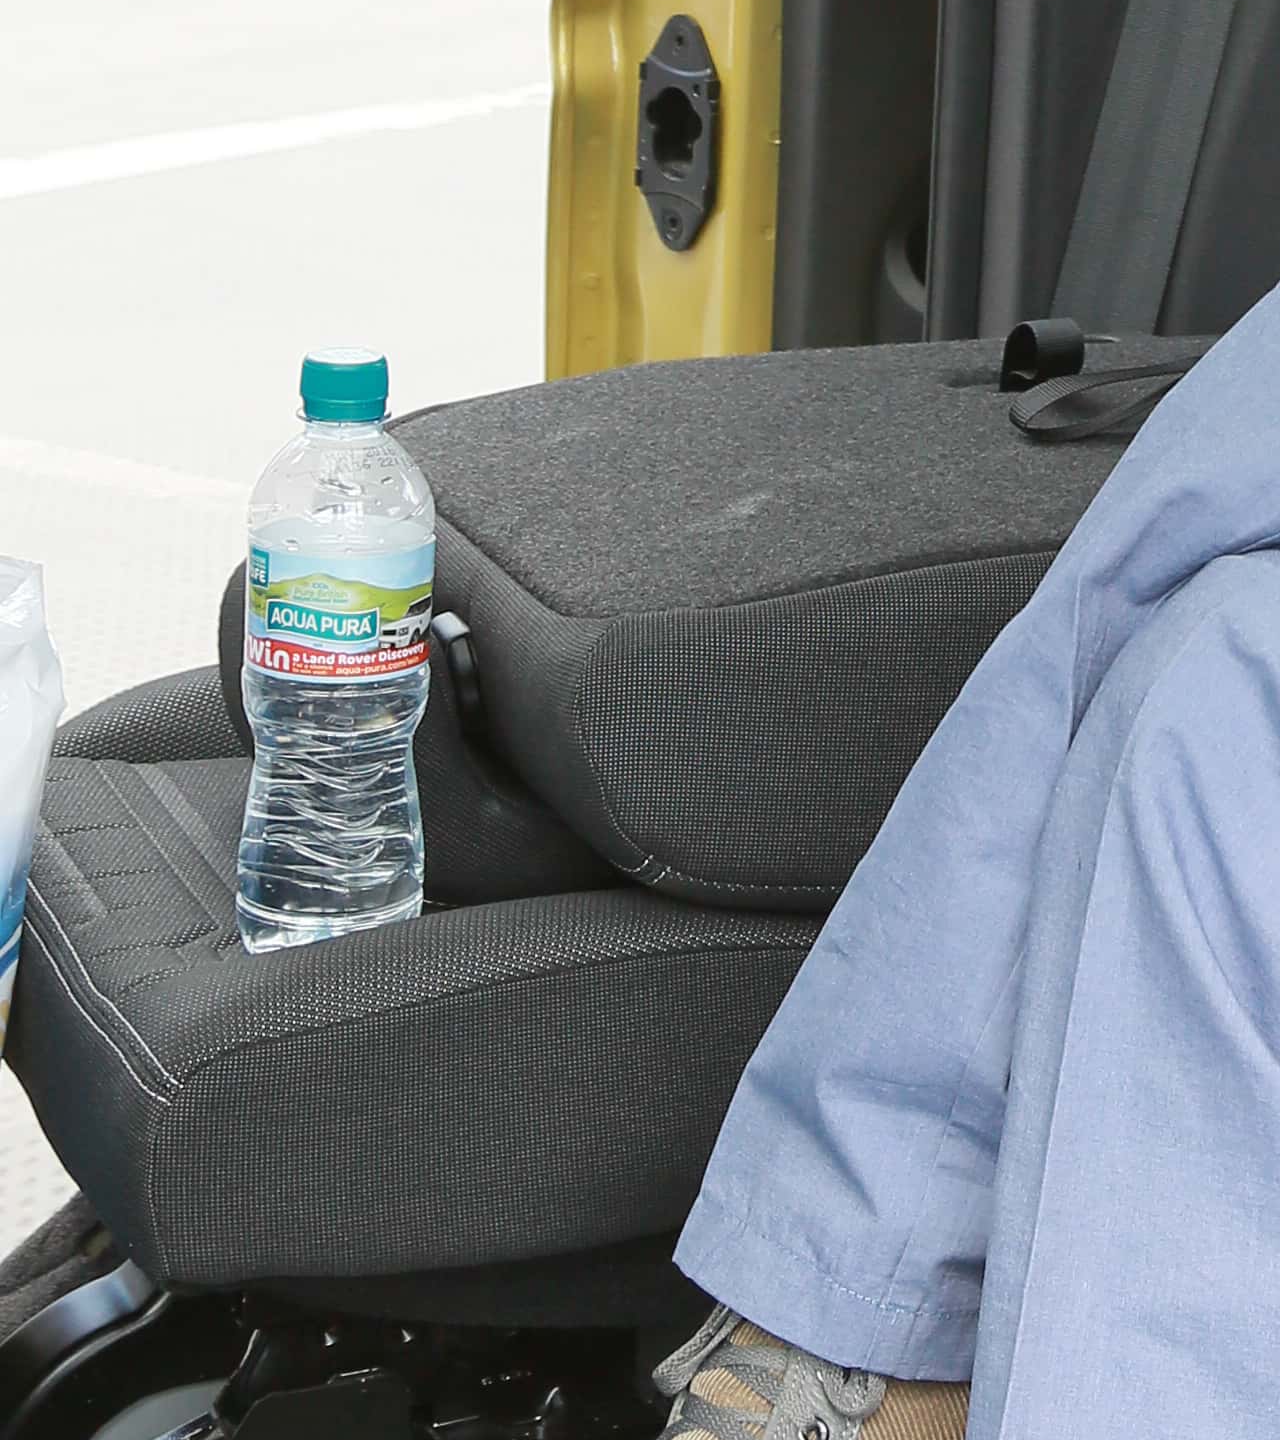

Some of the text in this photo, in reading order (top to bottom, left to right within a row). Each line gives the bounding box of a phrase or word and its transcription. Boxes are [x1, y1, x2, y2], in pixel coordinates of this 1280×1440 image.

[271, 606, 372, 637] AQUA PURA
[250, 638, 425, 671] Win a Land Rover Discovery
